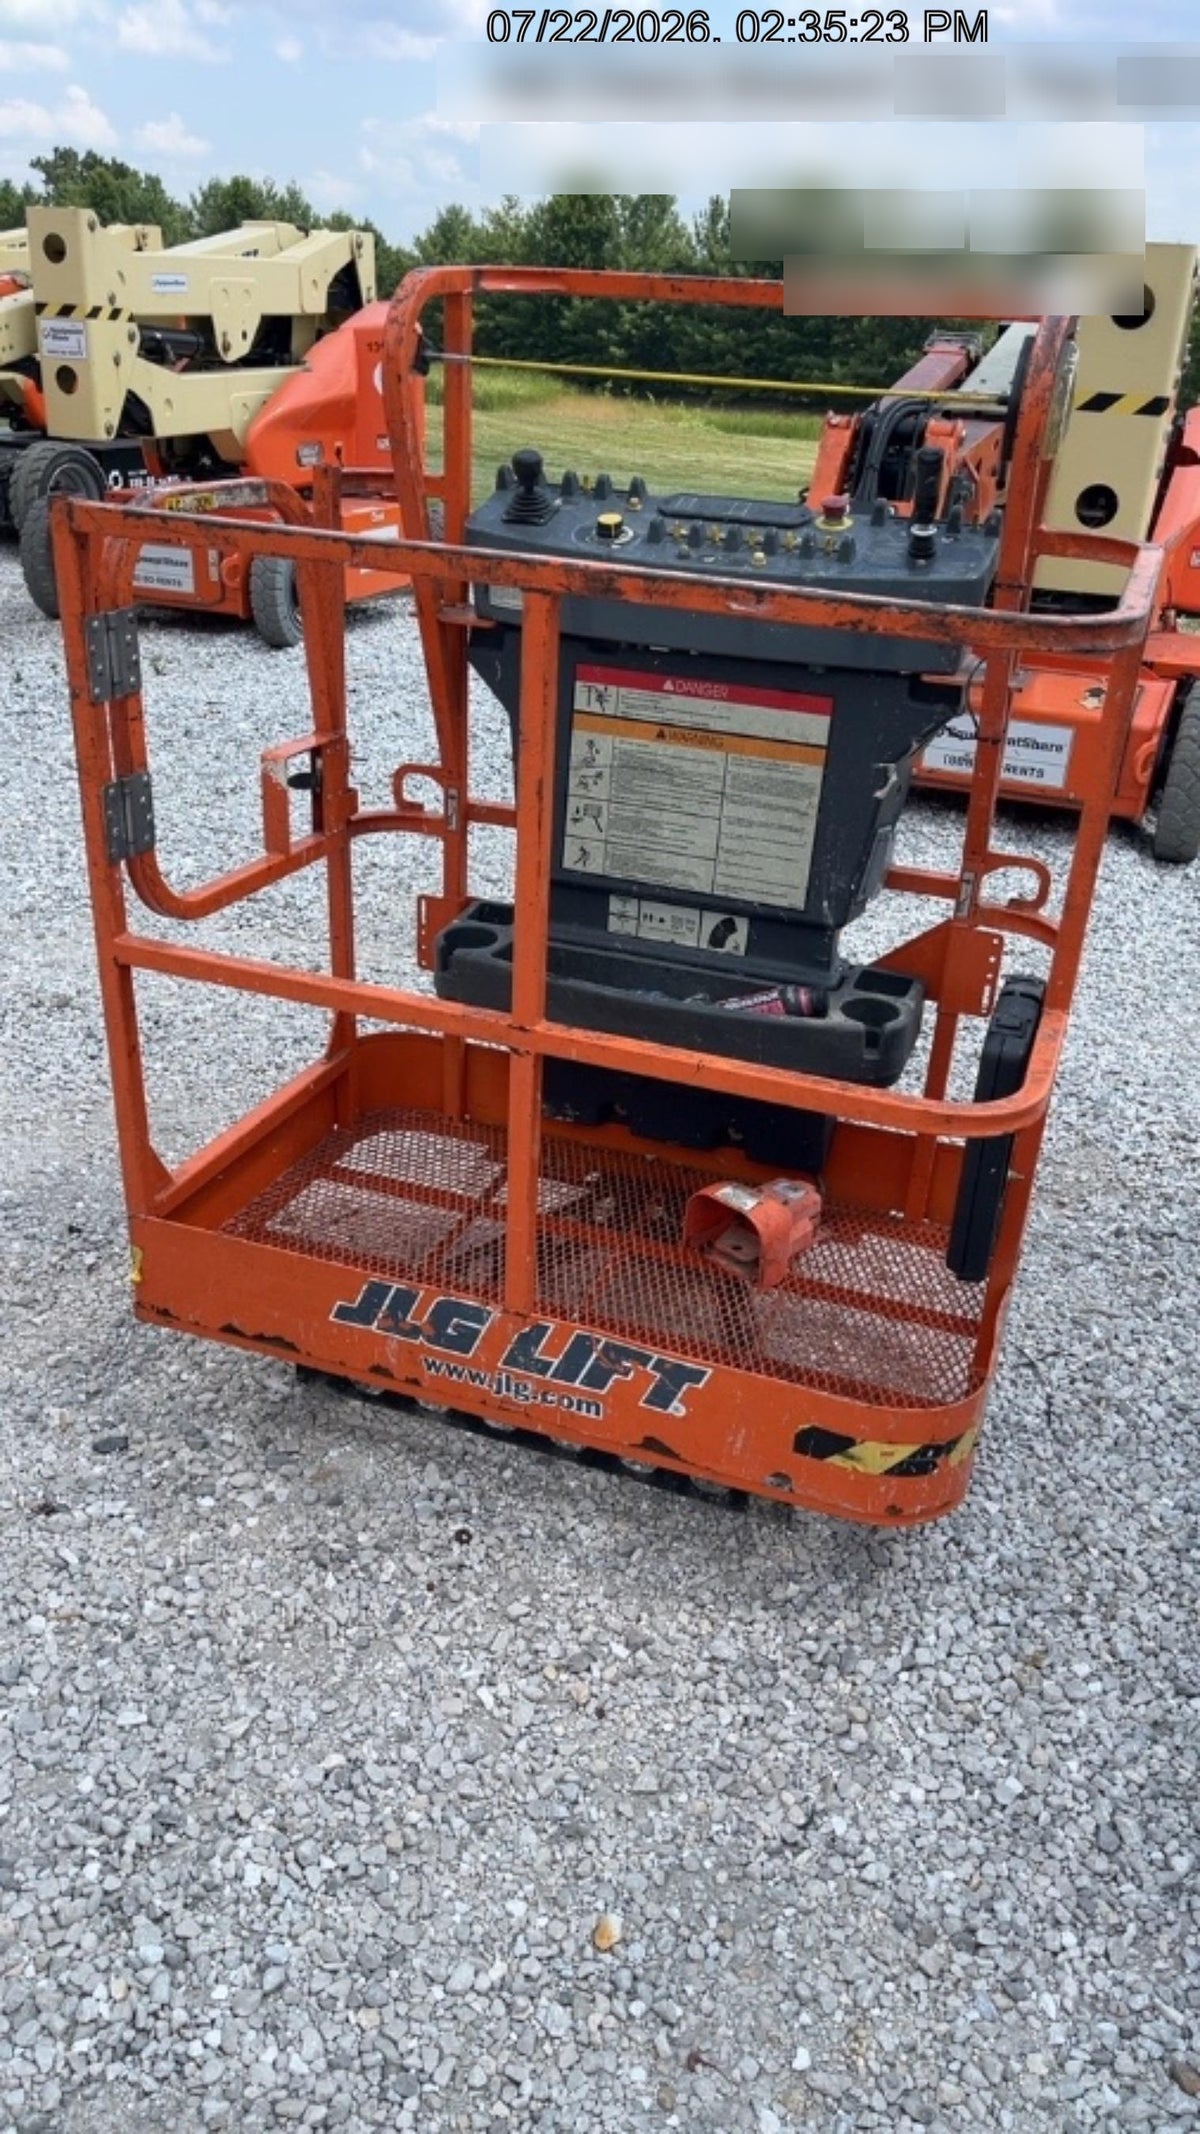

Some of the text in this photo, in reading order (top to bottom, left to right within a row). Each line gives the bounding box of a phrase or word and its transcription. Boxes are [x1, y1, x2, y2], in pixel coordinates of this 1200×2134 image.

[675, 680, 728, 698] DANGER
[671, 731, 724, 748] WARNING
[330, 1278, 712, 1412] JLG LIFT
[423, 1356, 602, 1419] www.jlg.com
